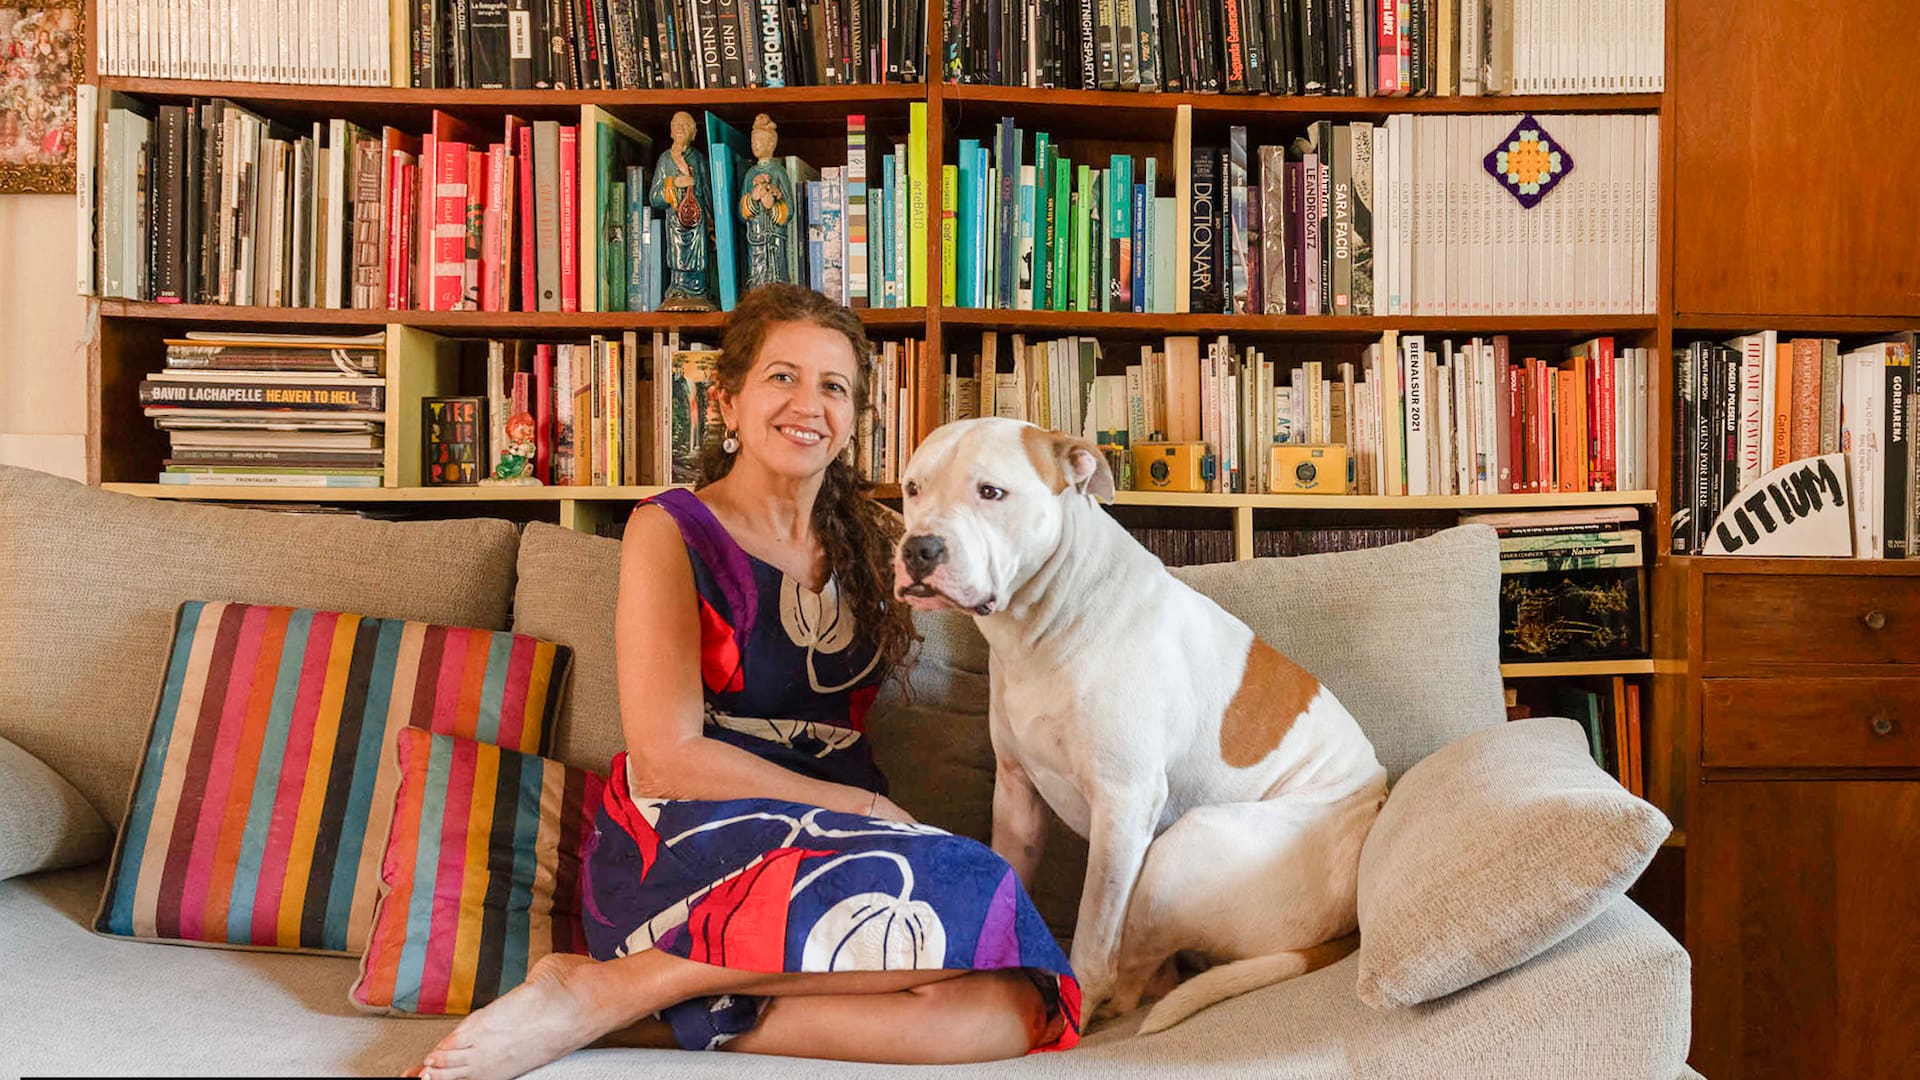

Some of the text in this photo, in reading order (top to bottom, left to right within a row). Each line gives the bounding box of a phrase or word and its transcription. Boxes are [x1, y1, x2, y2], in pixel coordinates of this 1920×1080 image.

[702, 27, 721, 68] JOHN
[722, 25, 740, 60] JOHN
[1228, 43, 1243, 81] Segunda
[1321, 164, 1330, 193] Arthur
[491, 183, 502, 212] Leyendo
[1193, 183, 1212, 292] DICTIONARY
[1335, 183, 1347, 259] SARA FACIO
[609, 347, 617, 388] Mongolian
[1701, 348, 1709, 373] HELMUT
[1727, 362, 1737, 391] ROGELIO
[153, 388, 359, 405] DAVID LACHAPELLE HEAVEN TO HELL
[1409, 342, 1421, 433] BIENALSUR 2021
[1727, 392, 1736, 431] POLESELLO
[1746, 343, 1760, 471] HELMUT NEWTON
[1892, 376, 1902, 443] GORRIARENA
[1700, 427, 1708, 451] GUN
[1777, 414, 1788, 444] Carlos
[1700, 452, 1708, 475] FOR
[1699, 476, 1708, 508] HIRE
[1716, 459, 1844, 553] LITIUM
[1570, 547, 1606, 557] Nabokov
